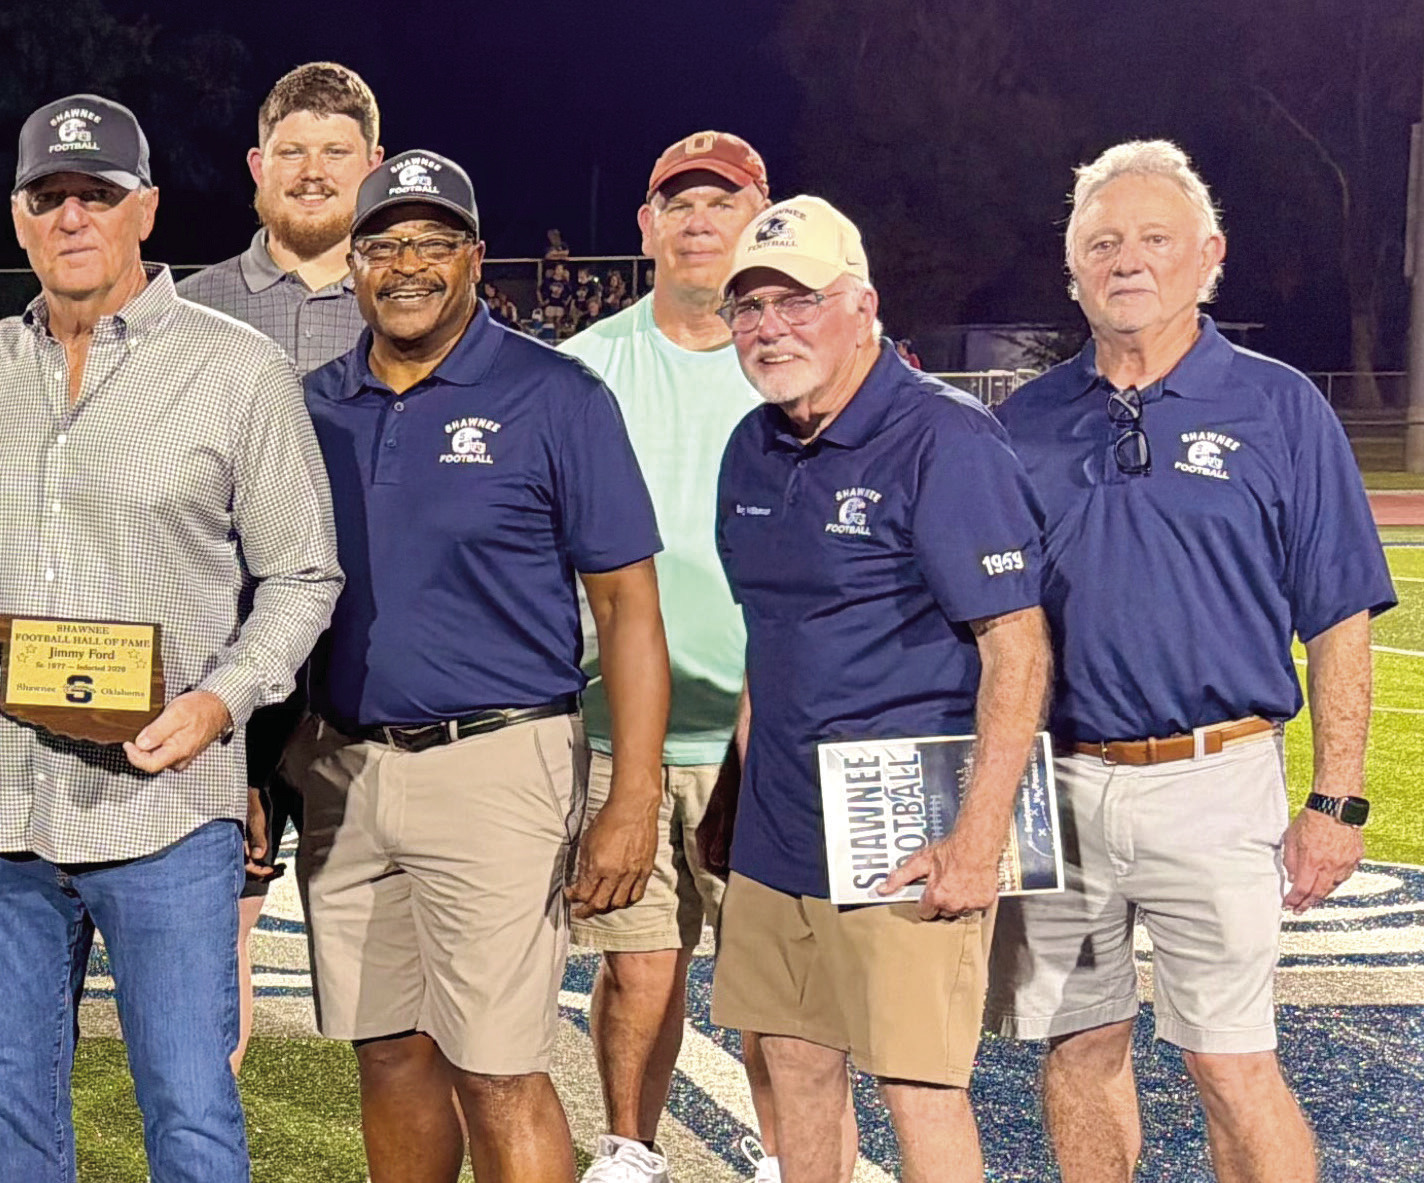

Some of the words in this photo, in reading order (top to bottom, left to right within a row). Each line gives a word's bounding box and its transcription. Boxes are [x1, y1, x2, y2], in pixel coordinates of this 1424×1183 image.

[50, 108, 102, 126] SHAWNEE
[48, 141, 101, 153] FOOTBALL
[390, 157, 442, 173] SHAWNEE
[389, 184, 440, 195] FOOTBALL
[746, 239, 798, 253] FOOTBALL
[444, 417, 501, 434] SHAWNEE
[1181, 431, 1241, 451] SHAWNEE
[439, 454, 494, 465] FOOTBALL
[1174, 461, 1230, 480] FOOTBALL
[835, 487, 882, 504] SHAWNEE
[825, 523, 872, 536] FOOTBALL
[56, 625, 110, 634] SHAWNEE
[15, 633, 71, 643] FOOTBALL
[74, 636, 100, 645] HALL
[120, 639, 150, 647] FAME
[48, 647, 84, 660] Jimmy
[89, 649, 115, 660] Ford
[17, 683, 56, 693] Shawnee
[101, 688, 145, 697] Oklahoma
[843, 756, 889, 890] SHAWNEE
[888, 754, 928, 885] OTBALL
